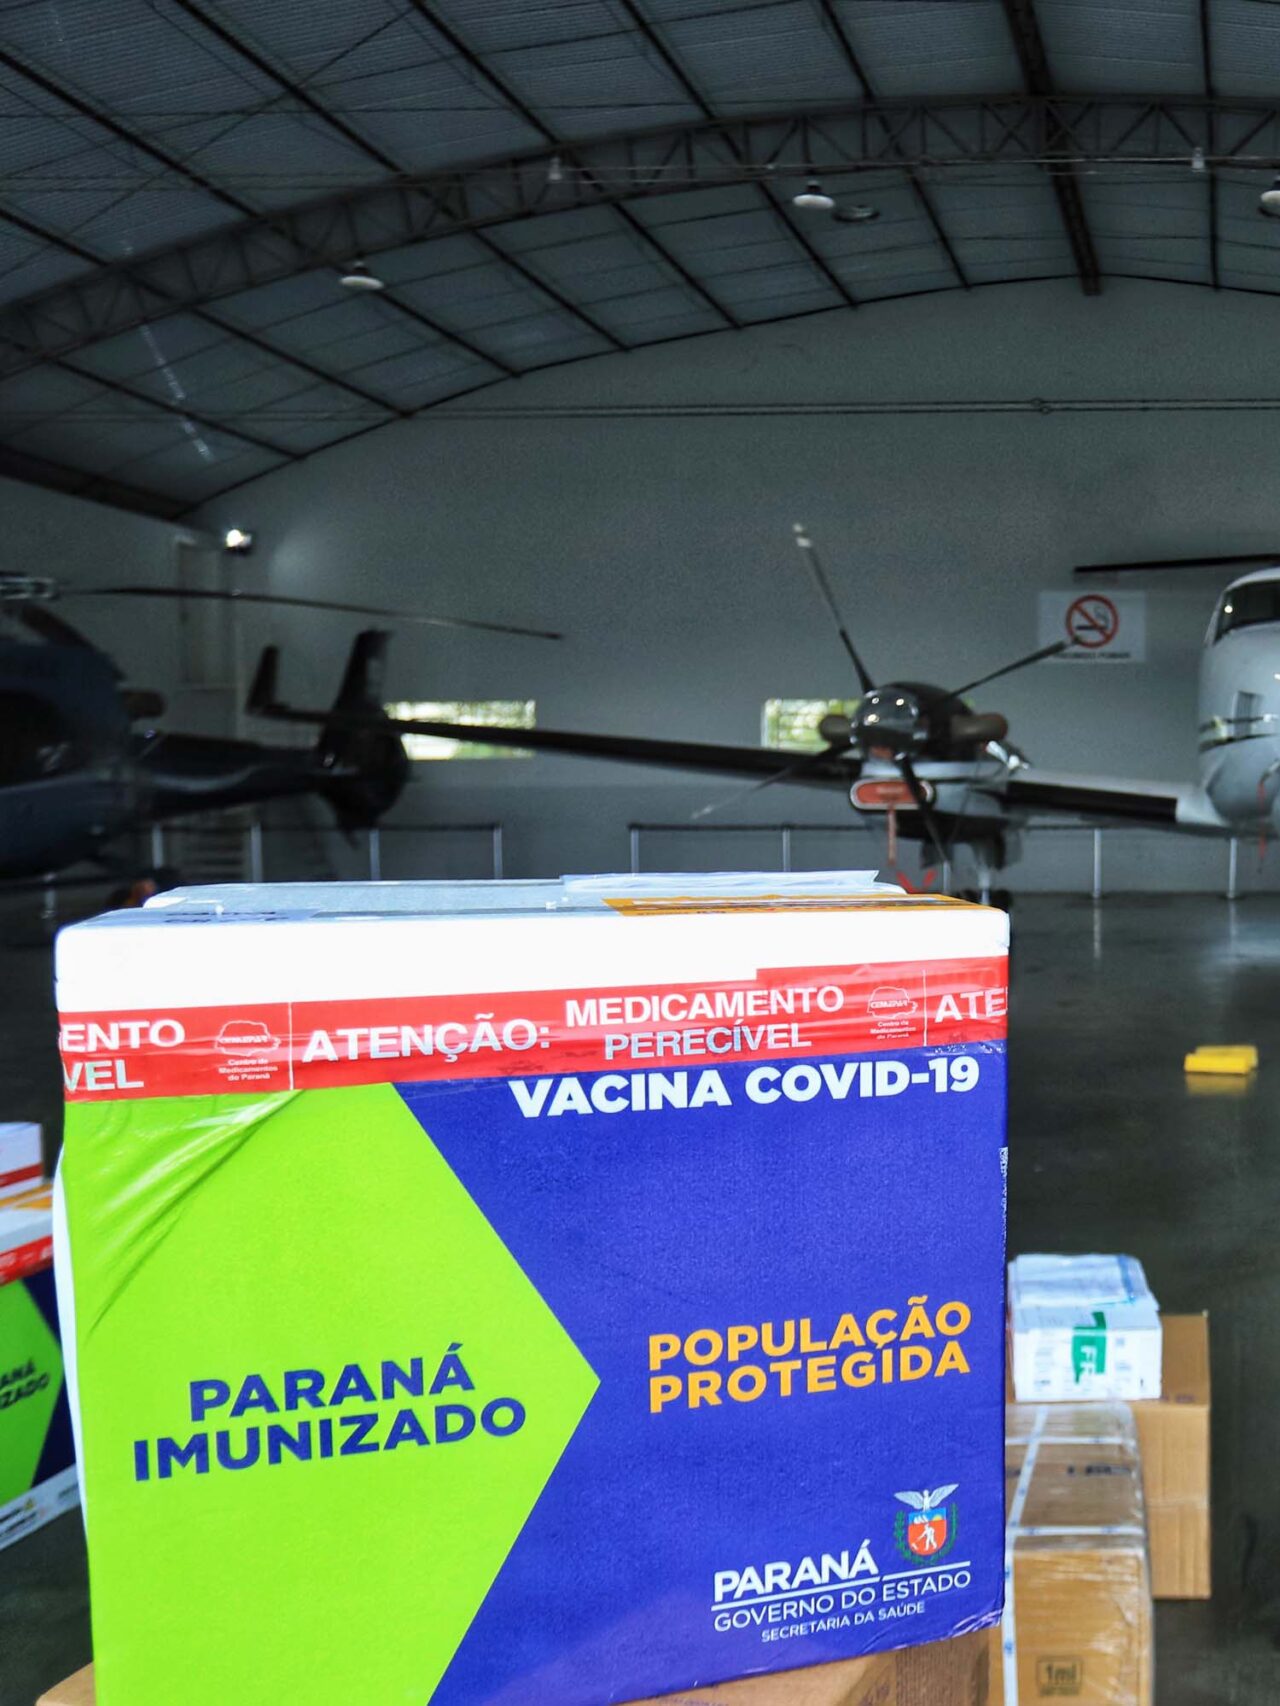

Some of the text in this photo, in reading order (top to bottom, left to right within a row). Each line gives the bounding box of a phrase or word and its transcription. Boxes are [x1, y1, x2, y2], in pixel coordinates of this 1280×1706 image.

[566, 985, 845, 1028] MEDICAMENTO
[935, 986, 1008, 1022] ATE
[58, 1019, 186, 1052] ENTO
[302, 1013, 550, 1063] ATENÇÃO:
[605, 1019, 812, 1060] PERECÍVEL
[63, 1059, 145, 1094] VEL
[508, 1056, 980, 1118] VACINA COVID-19
[649, 1294, 972, 1371] POPULAÇÃO
[189, 1342, 475, 1422] PARANÁ
[649, 1340, 971, 1414] PROTEGIDA
[134, 1397, 527, 1481] IMUNIZADO
[714, 1538, 879, 1602] PARANÁ
[714, 1570, 971, 1632] GOVERNO DO ESTADO
[761, 1601, 925, 1642] SECRETARIA DA SAÚDE
